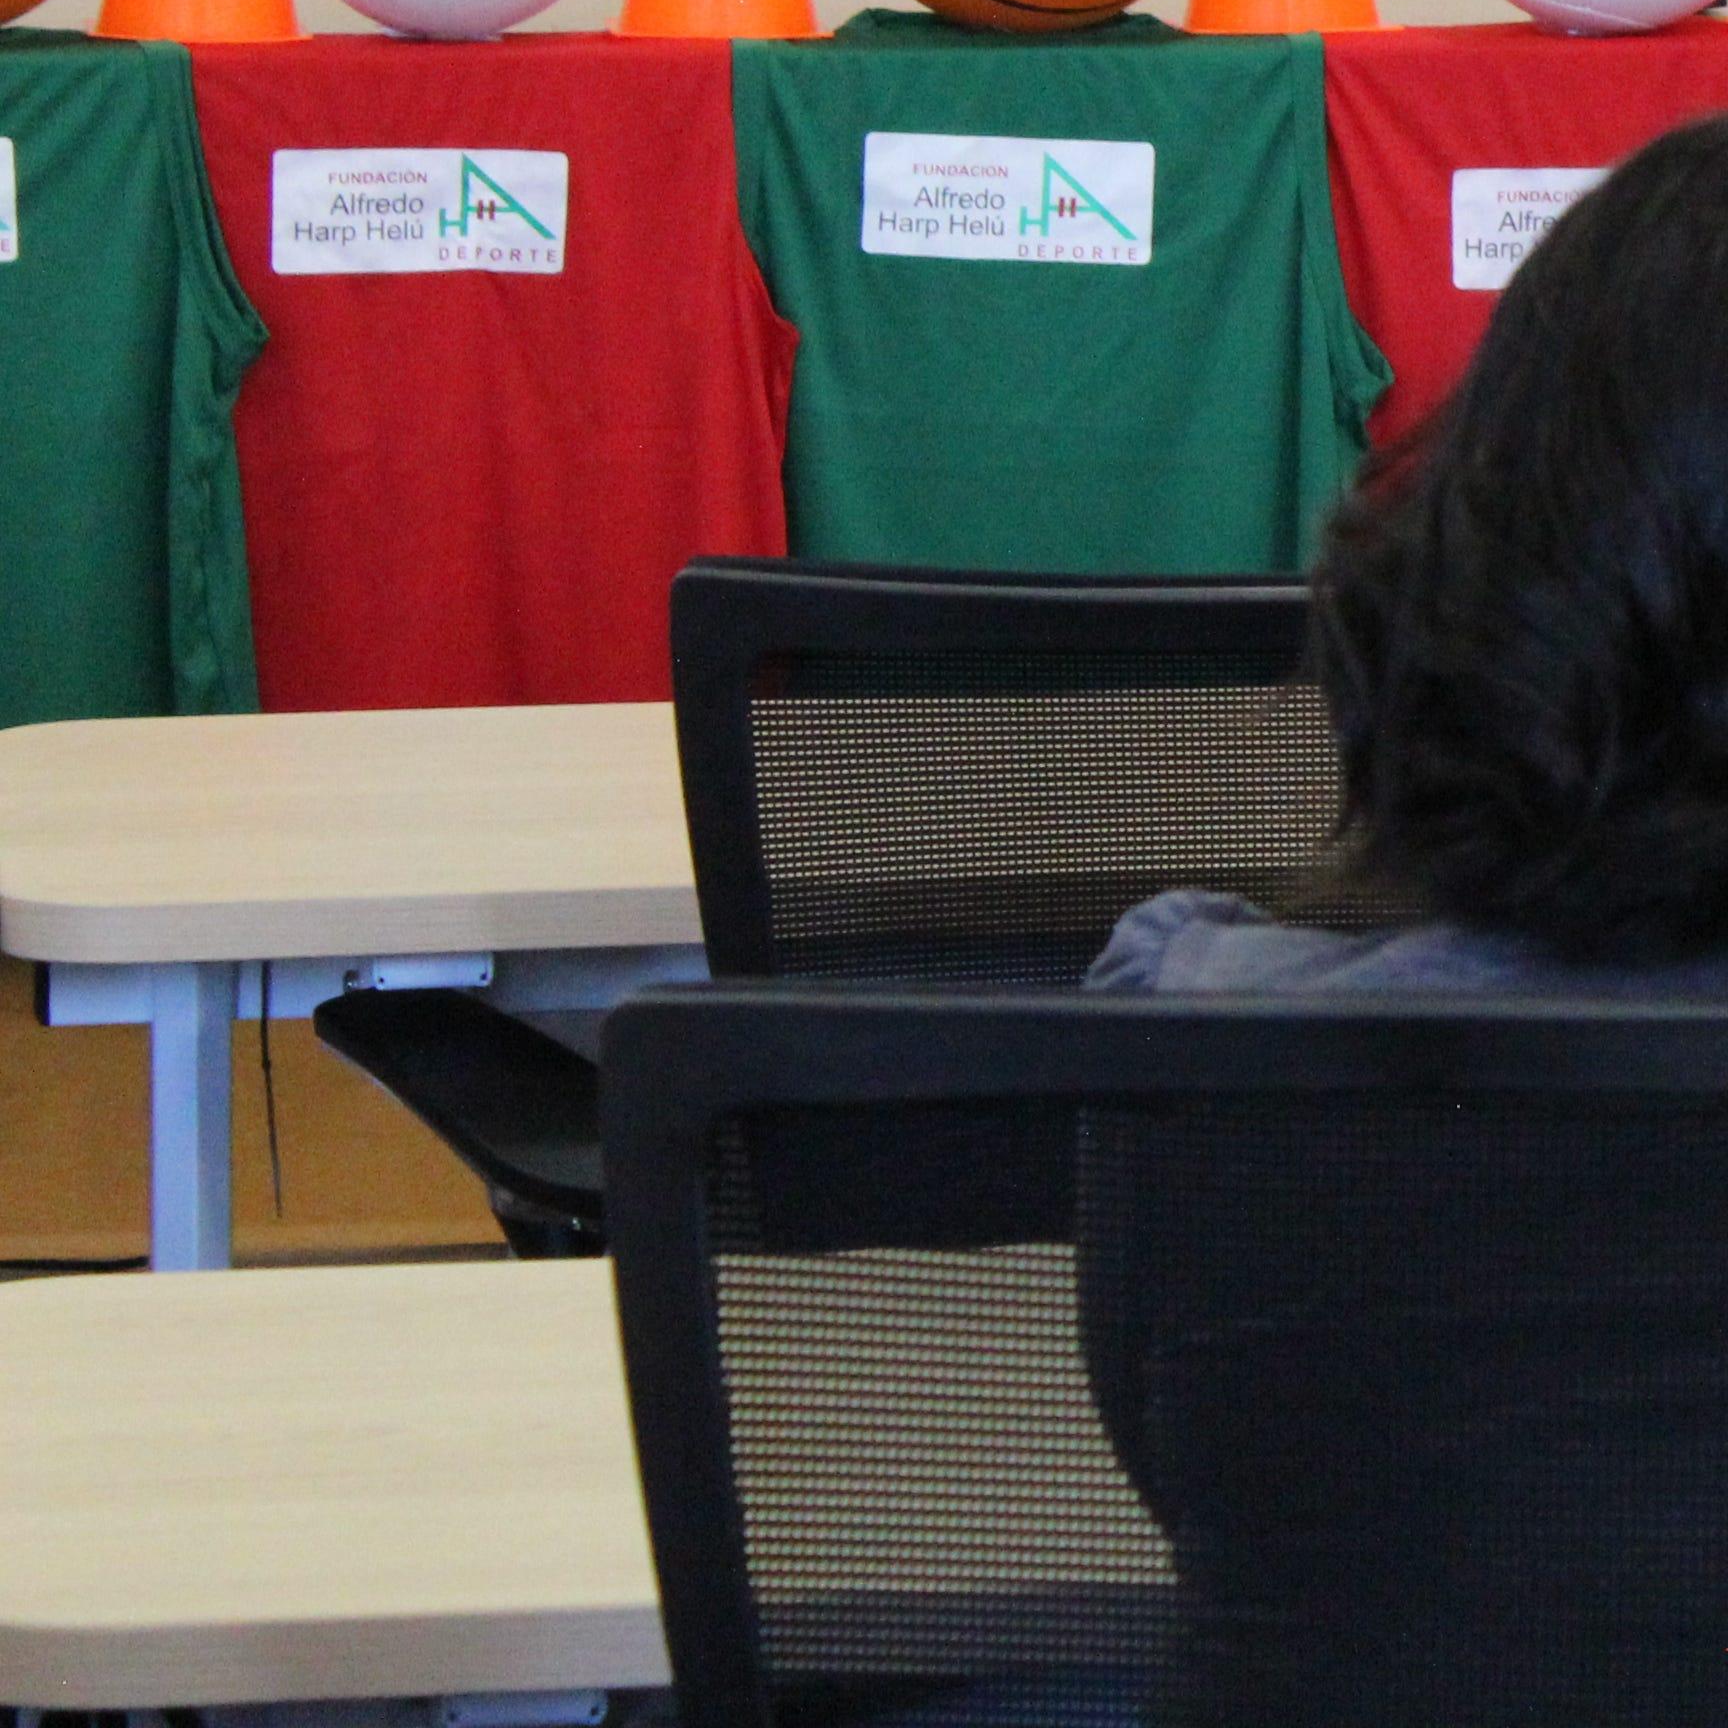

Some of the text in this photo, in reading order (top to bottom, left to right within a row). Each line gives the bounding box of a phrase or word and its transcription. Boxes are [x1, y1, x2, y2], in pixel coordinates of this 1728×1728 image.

[330, 193, 424, 214] Alfredo
[914, 186, 1005, 209] Alfredo
[1497, 191, 1584, 203] FUNDACIÓ
[879, 212, 1004, 238] Harp Helú
[1498, 211, 1559, 232] Alfre
[294, 220, 423, 245] Harp Helú
[439, 247, 557, 263] DEPORTE
[1018, 244, 1137, 261] DEPORTE
[1465, 238, 1523, 263] Harp
